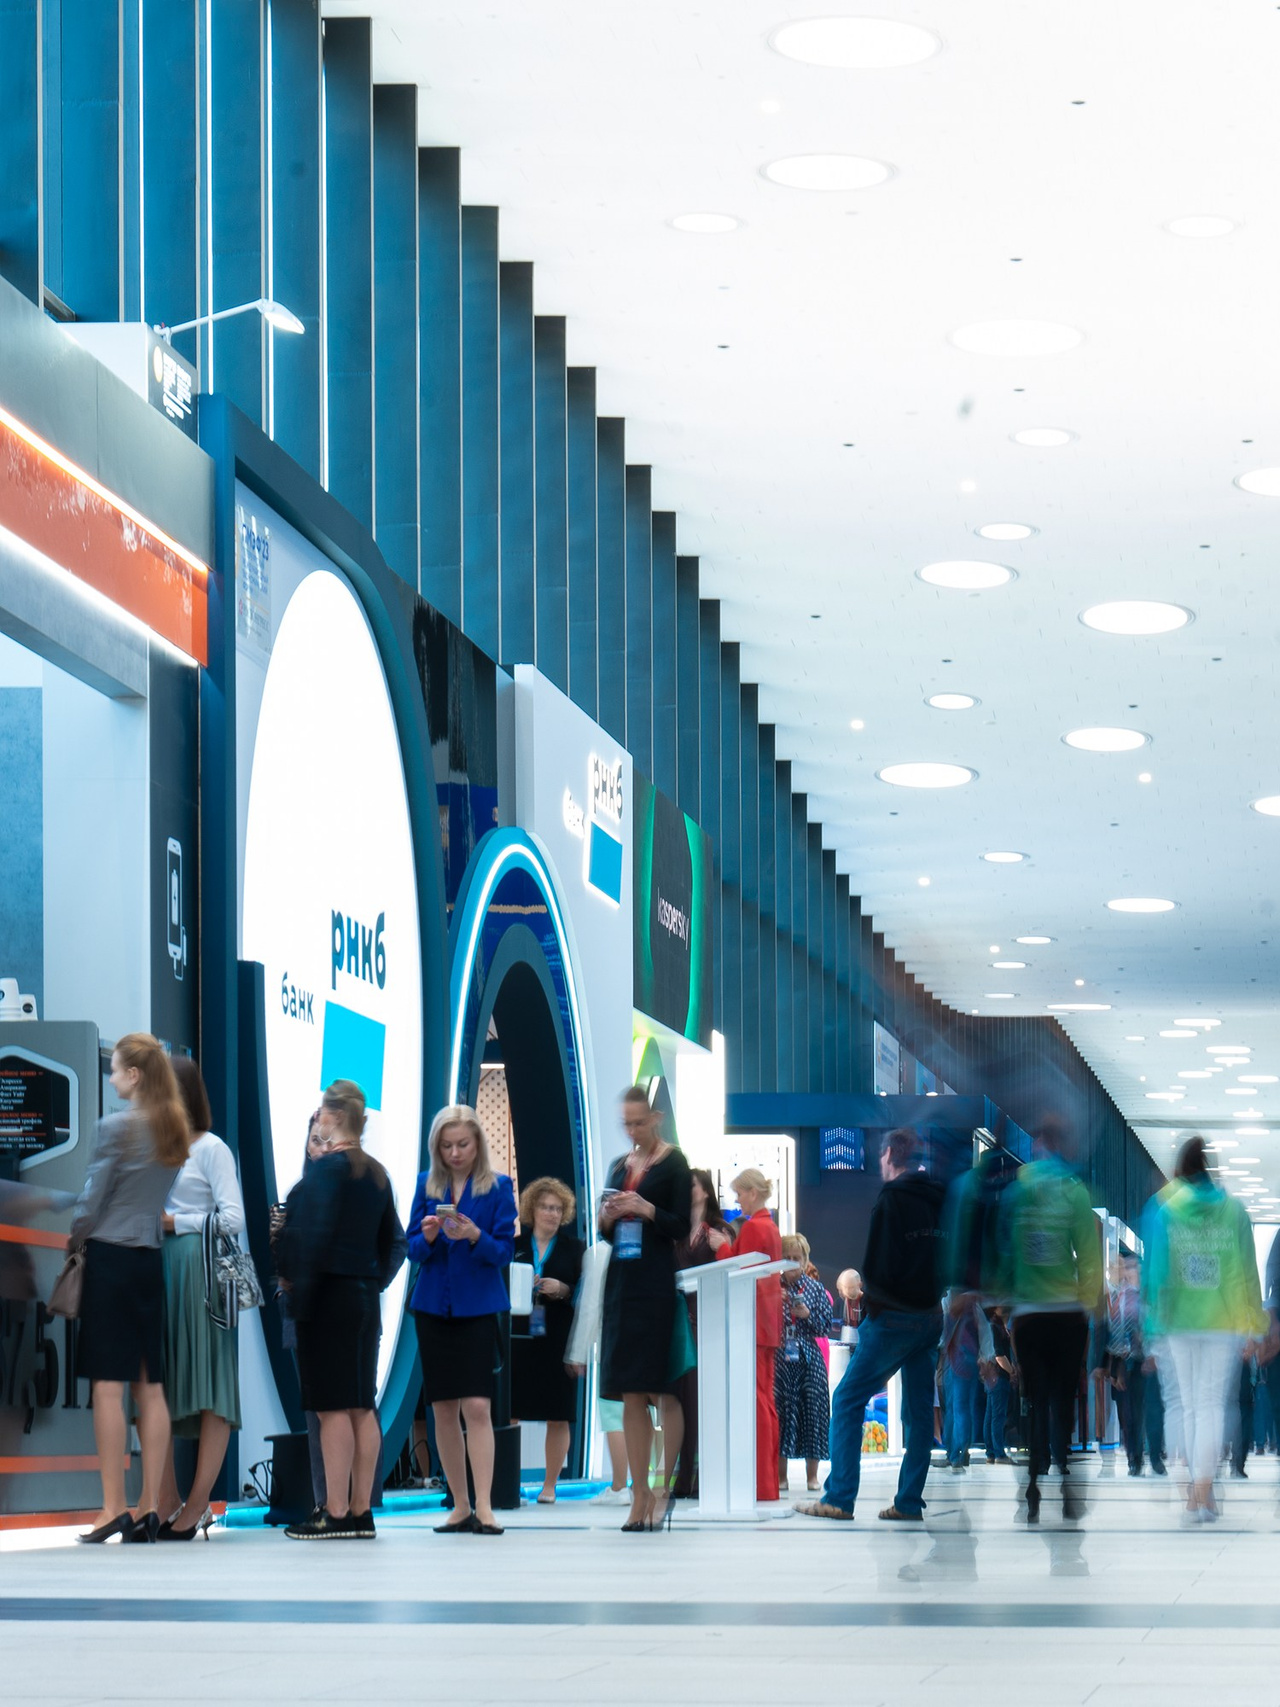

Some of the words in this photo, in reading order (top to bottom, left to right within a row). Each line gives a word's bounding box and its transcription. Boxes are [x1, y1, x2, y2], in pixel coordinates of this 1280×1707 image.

[331, 909, 387, 991] рнкб
[657, 886, 690, 951] kaspersky
[281, 971, 315, 1026] банк
